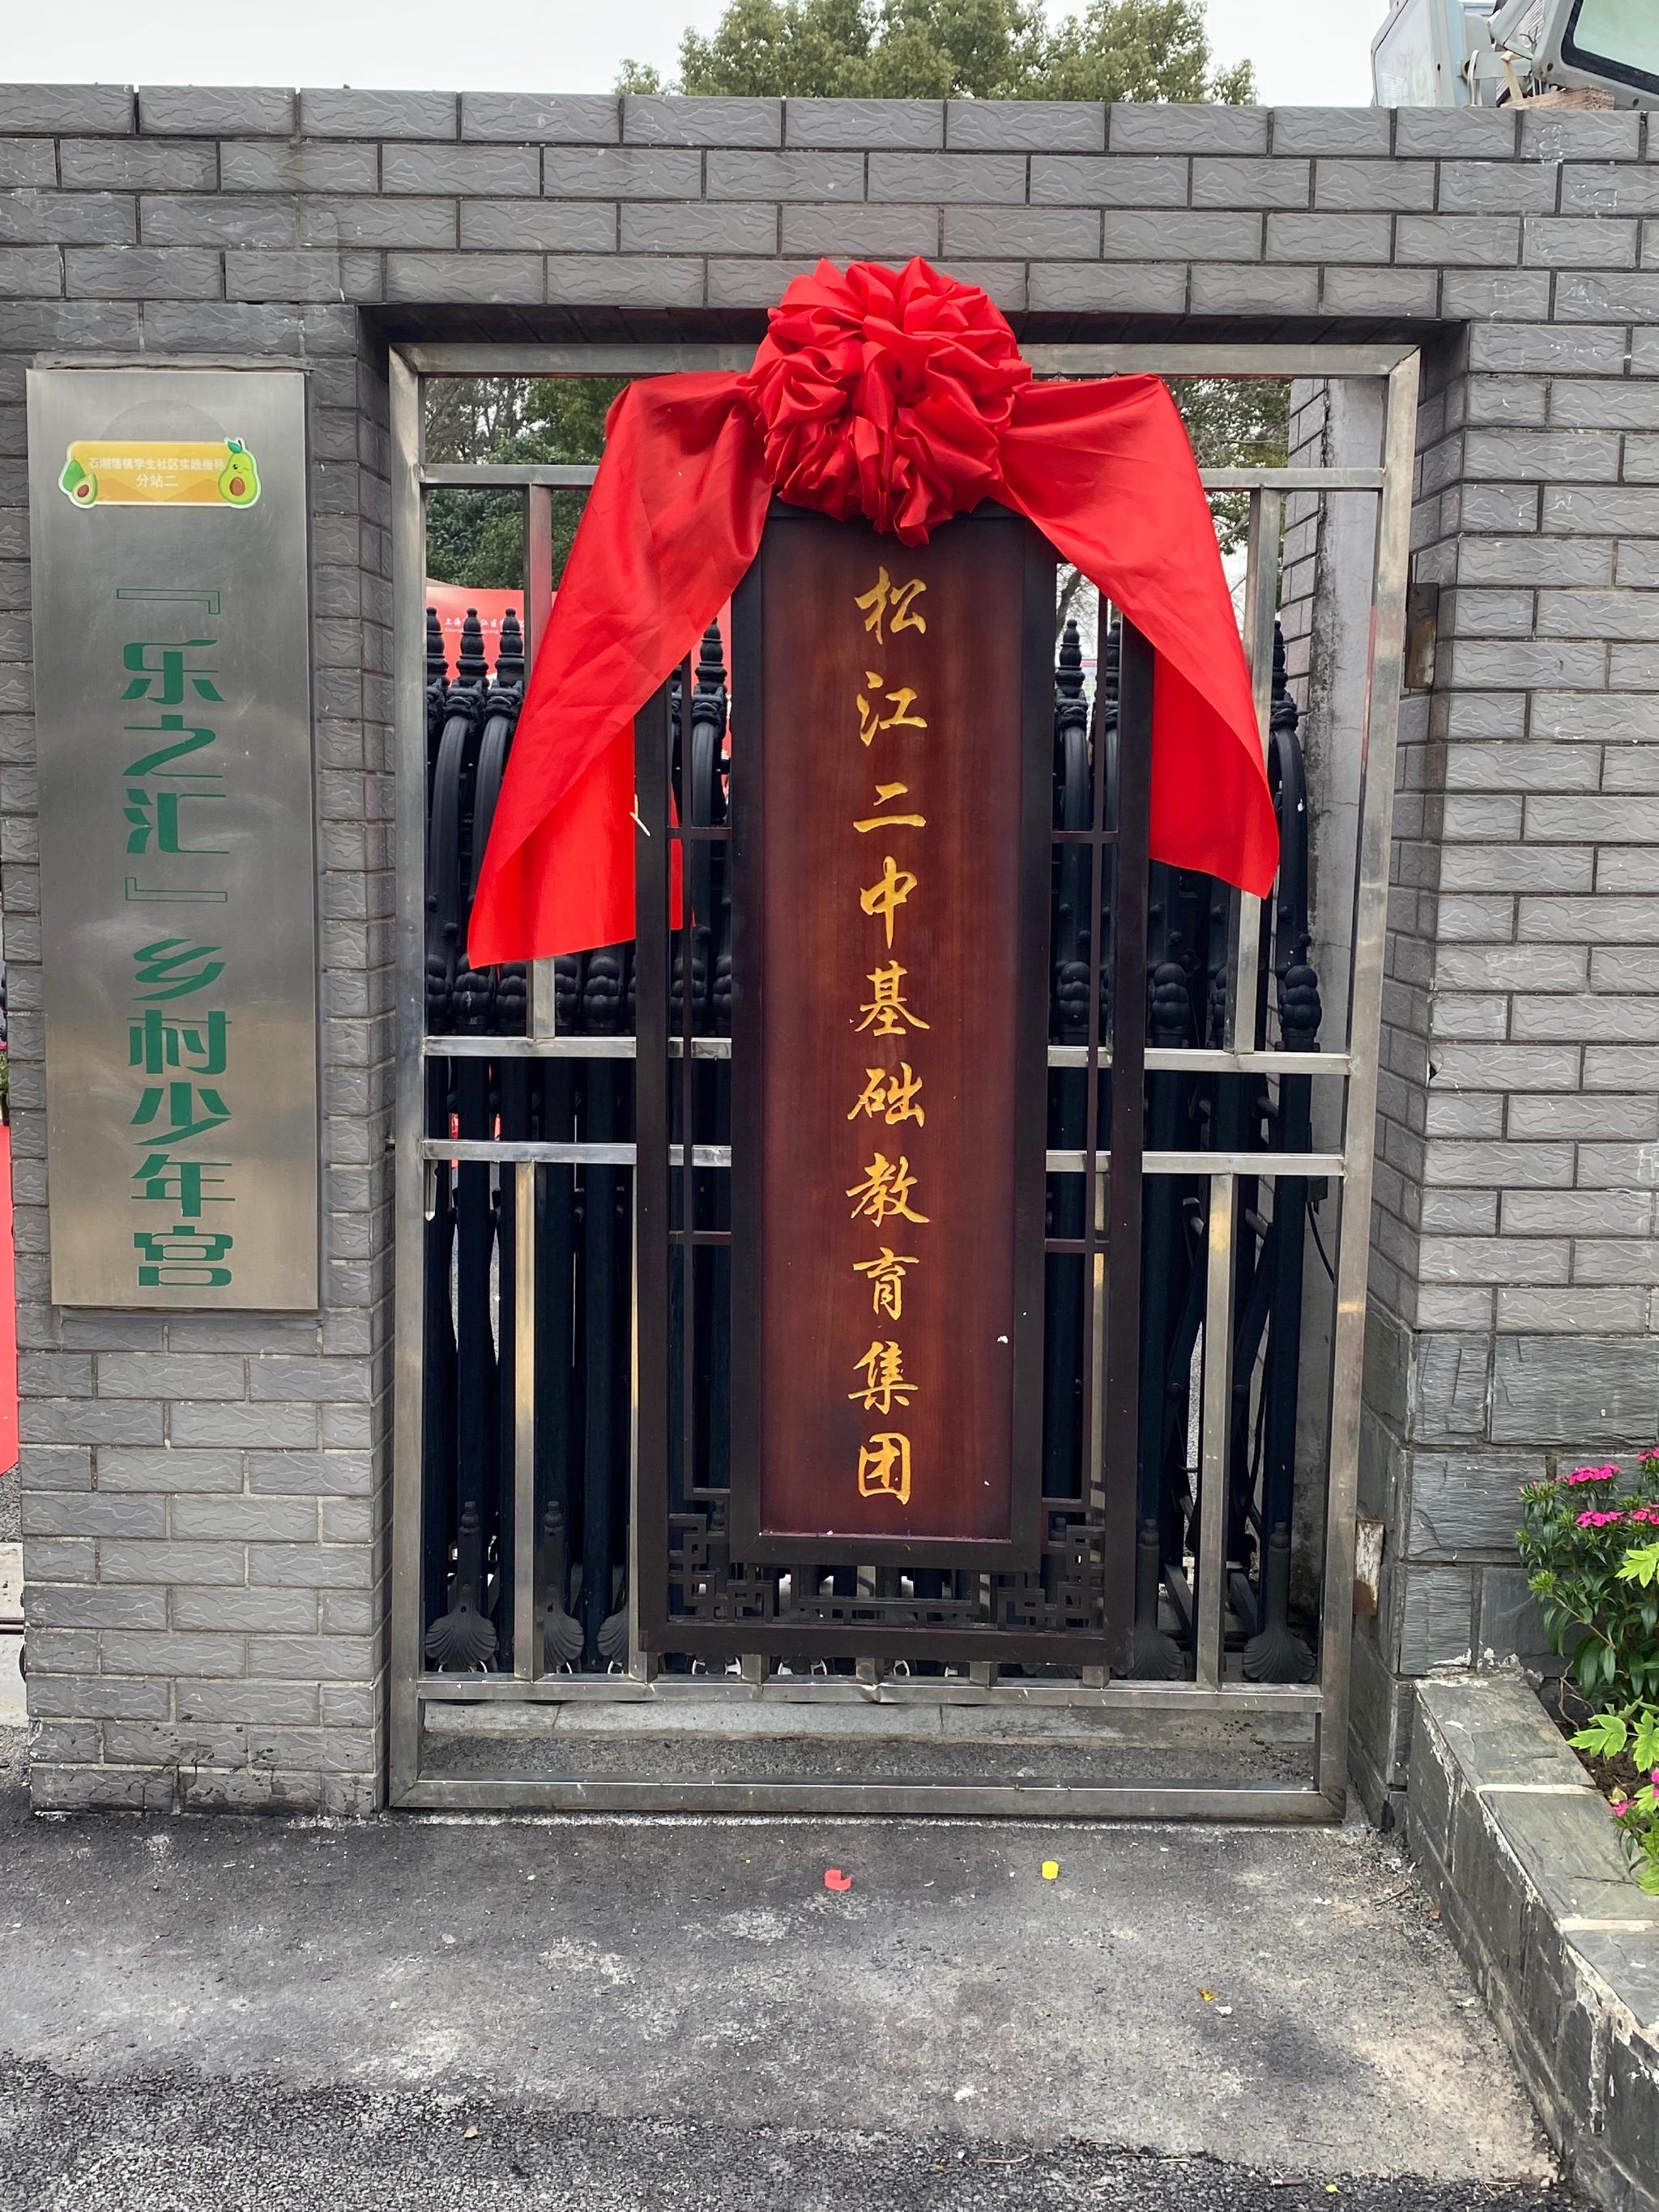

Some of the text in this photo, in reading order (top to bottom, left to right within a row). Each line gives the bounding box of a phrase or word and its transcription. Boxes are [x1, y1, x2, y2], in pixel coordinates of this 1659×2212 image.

[136, 473, 178, 488] 分站二
[846, 566, 931, 1505] 松江二中基础教育集团
